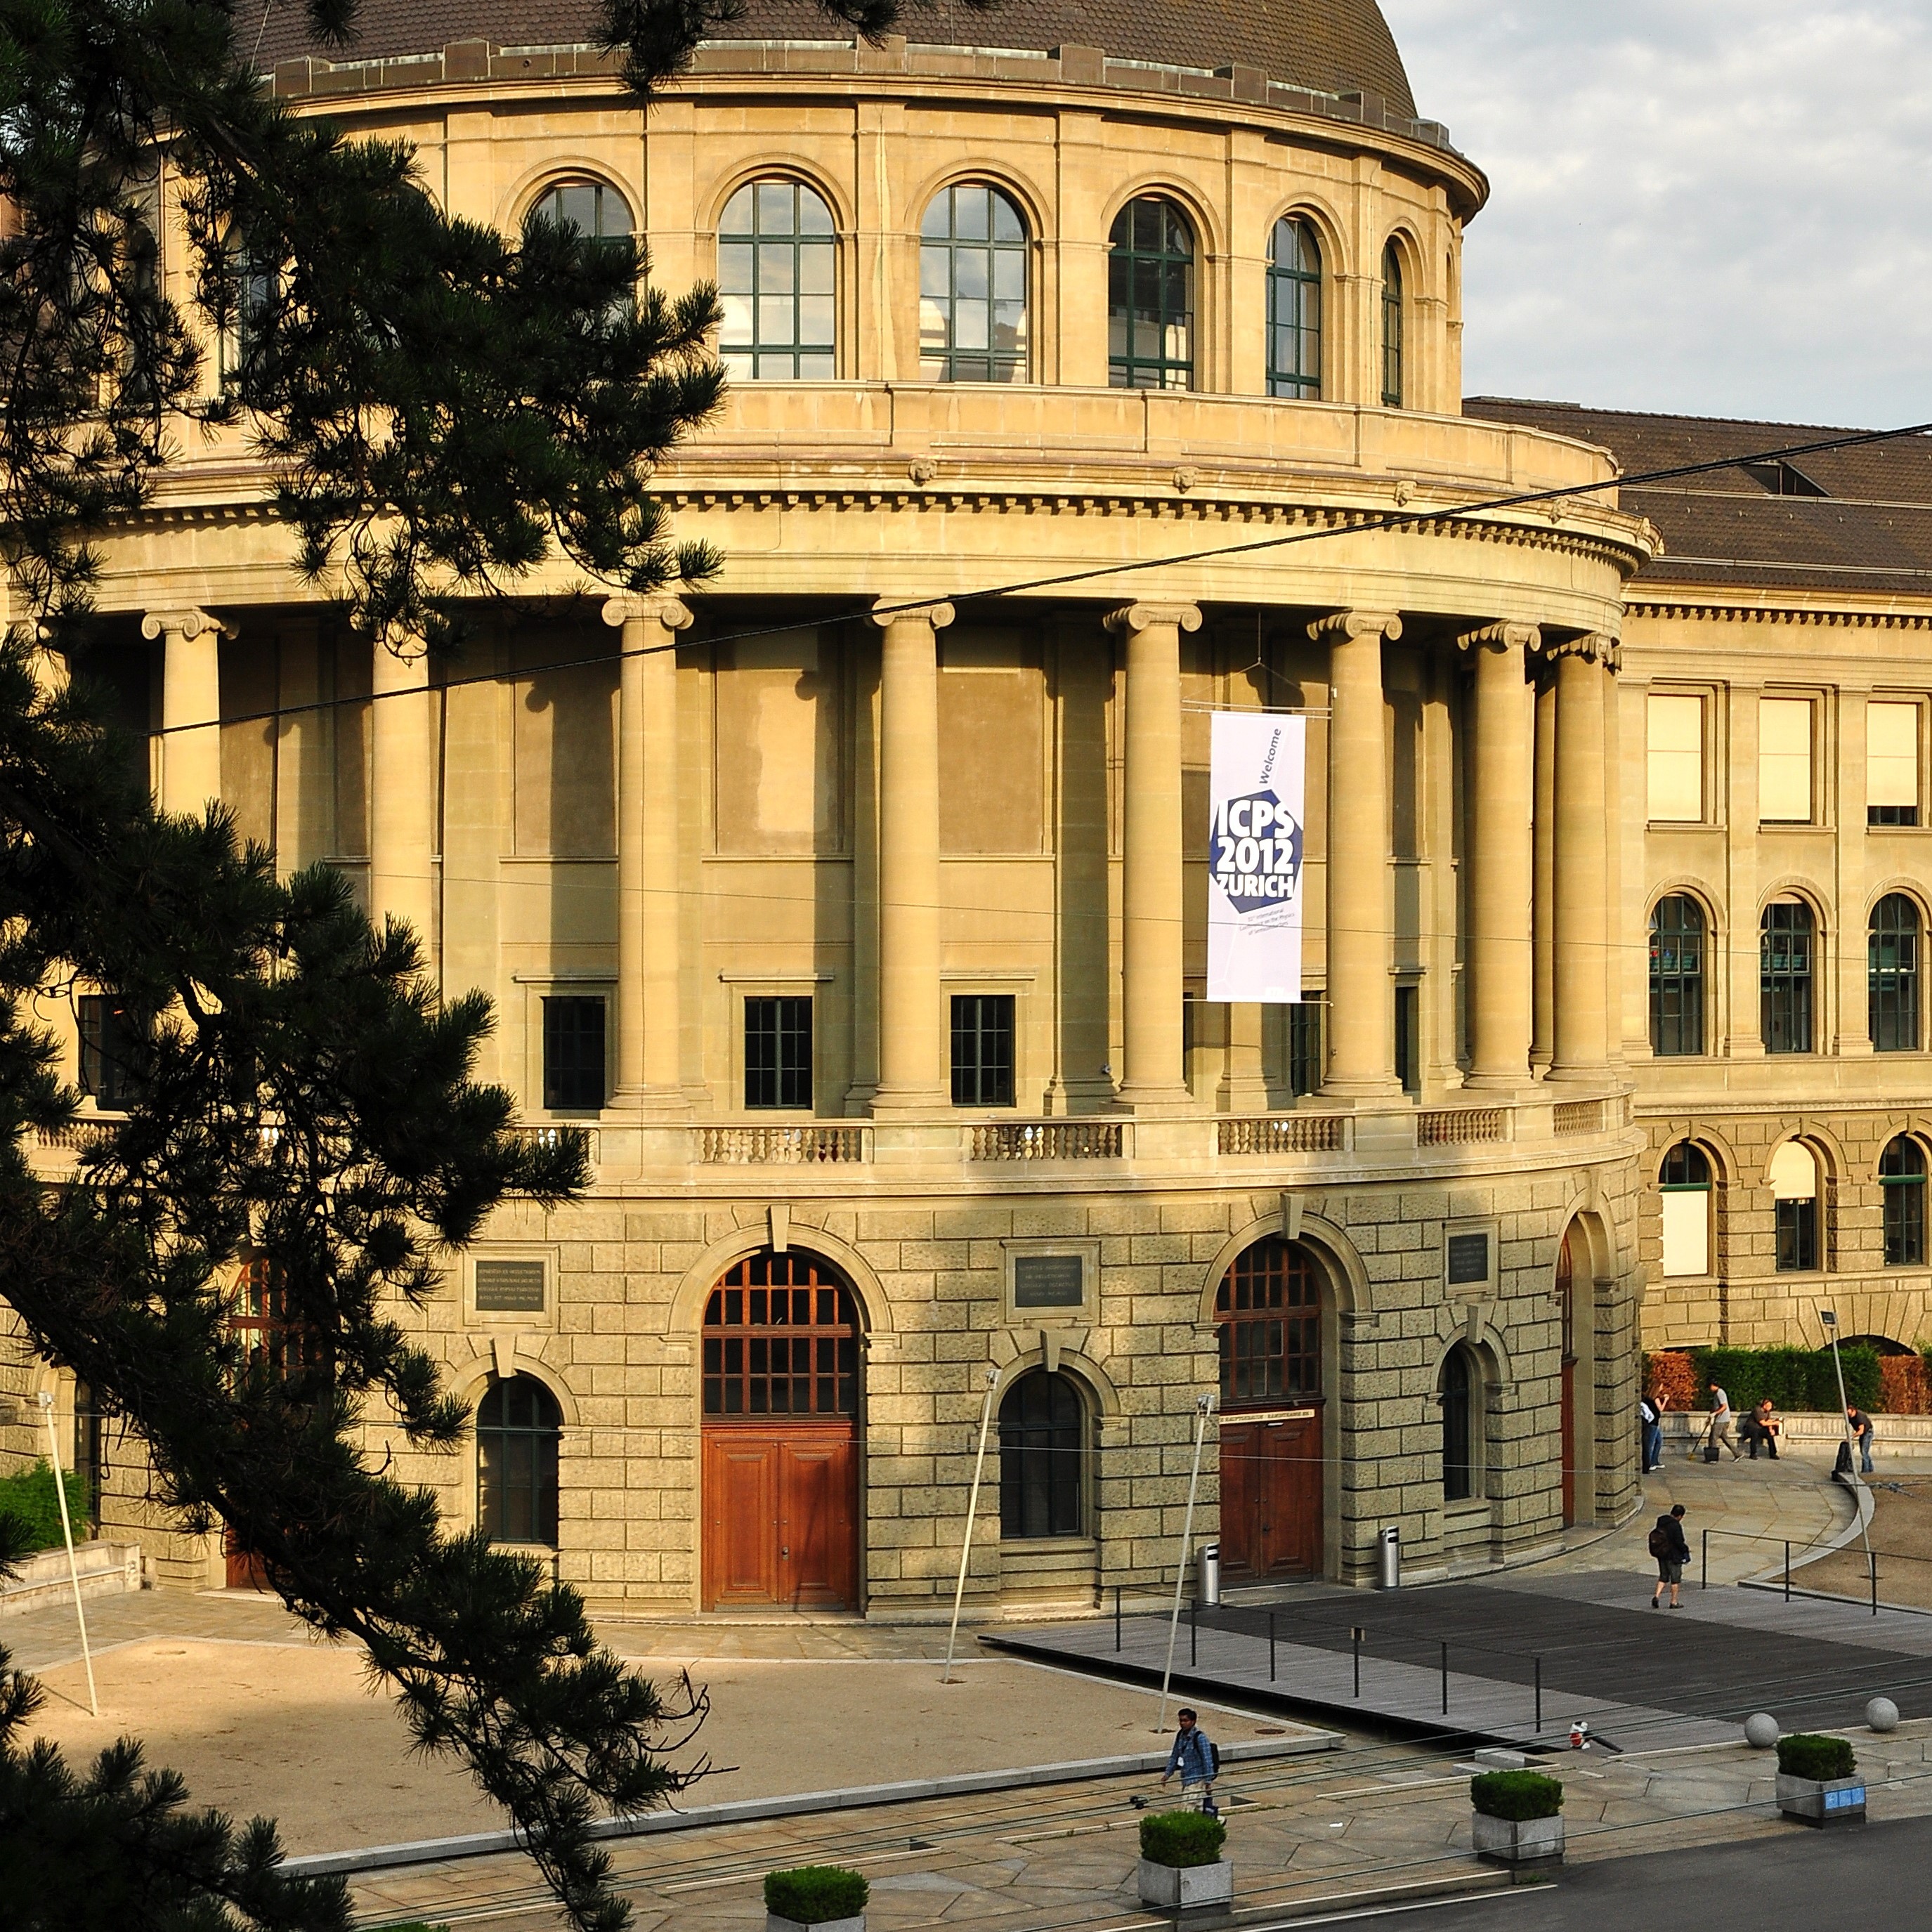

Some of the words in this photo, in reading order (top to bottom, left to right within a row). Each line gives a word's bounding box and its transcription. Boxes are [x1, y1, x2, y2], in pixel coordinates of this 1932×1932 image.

[1259, 728, 1281, 784] Welcome
[1217, 799, 1295, 839] ICPS
[1216, 836, 1294, 875] 2012
[1216, 873, 1294, 898] ZURICH
